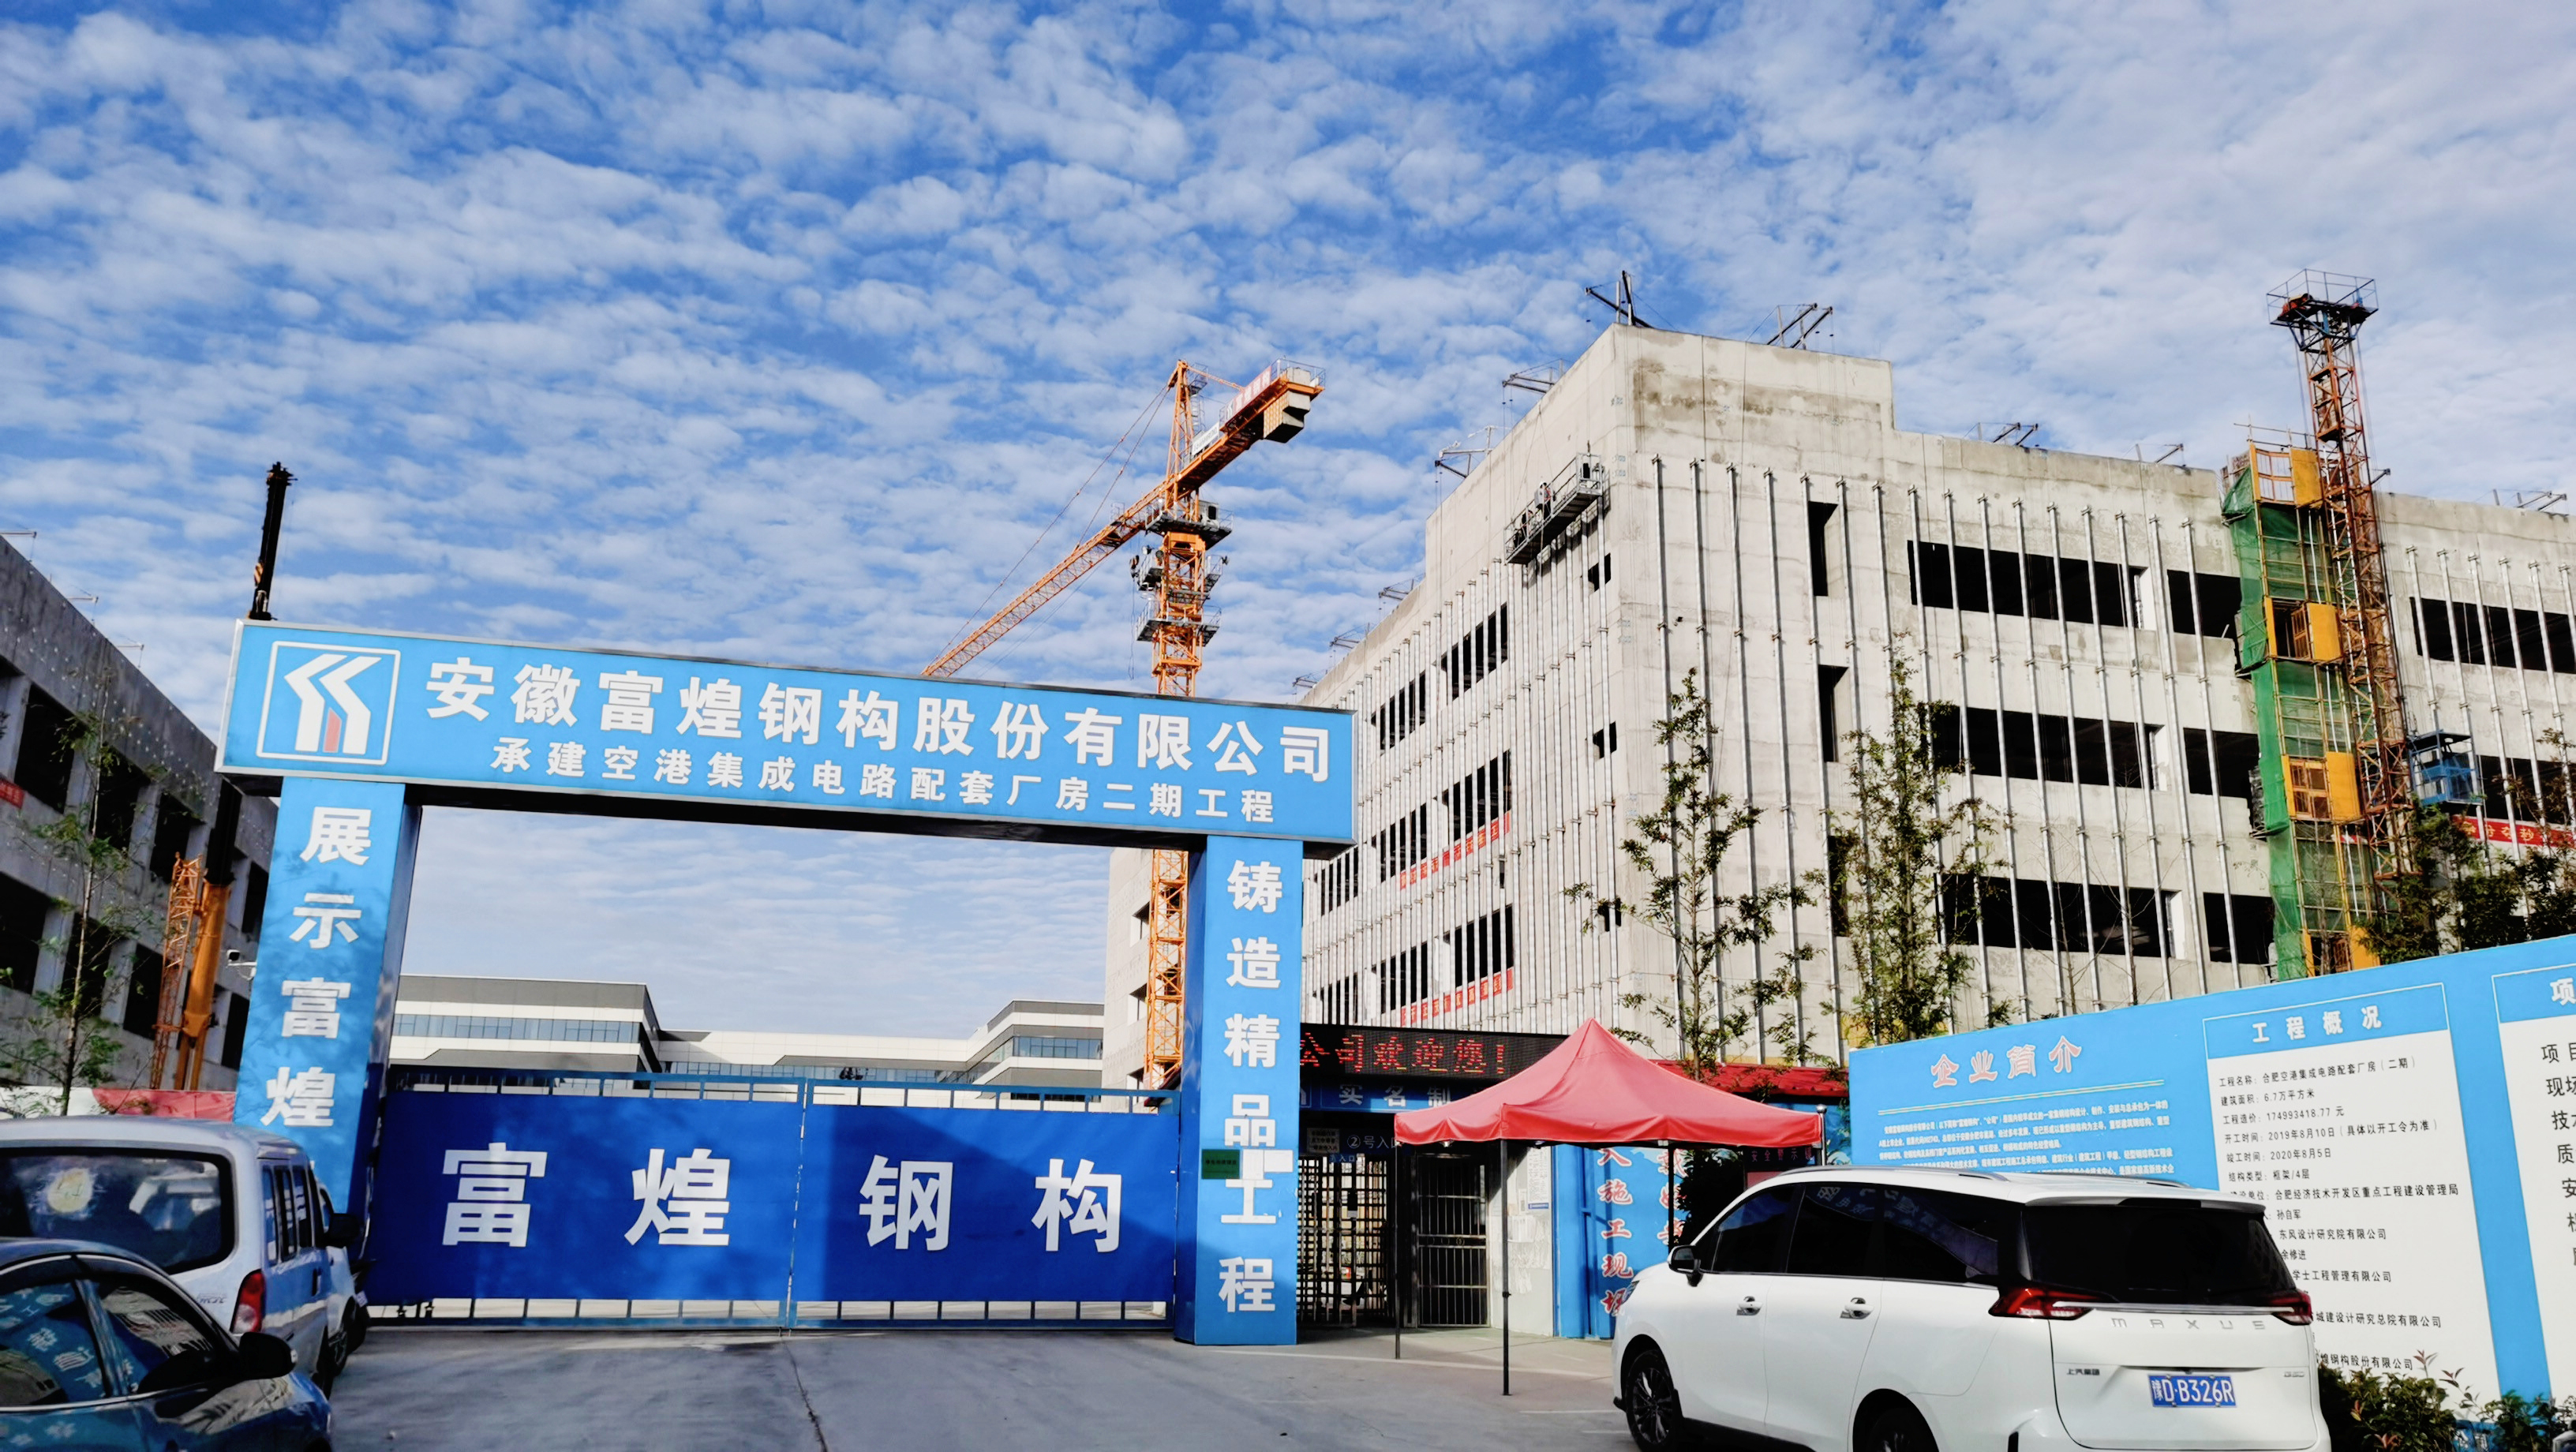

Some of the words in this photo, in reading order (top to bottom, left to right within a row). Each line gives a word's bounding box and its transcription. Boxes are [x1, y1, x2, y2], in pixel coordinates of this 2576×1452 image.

[426, 657, 1329, 783] 安徽富煌钢构股份有限公司
[490, 736, 1274, 823] 承建空港集成电路配套厂房二期工程
[260, 806, 372, 1127] 展示富煌
[2252, 1005, 2382, 1042] 工程概况
[1219, 859, 1282, 1313] 铸造精品工程
[1339, 1084, 1488, 1108] 实名制
[1930, 1035, 2082, 1088] 企业简介
[441, 1142, 1122, 1253] 富煌钢构
[2110, 1318, 2265, 1330] MAXUS
[2312, 1311, 2442, 1328] 城建设计研究总院有限公司
